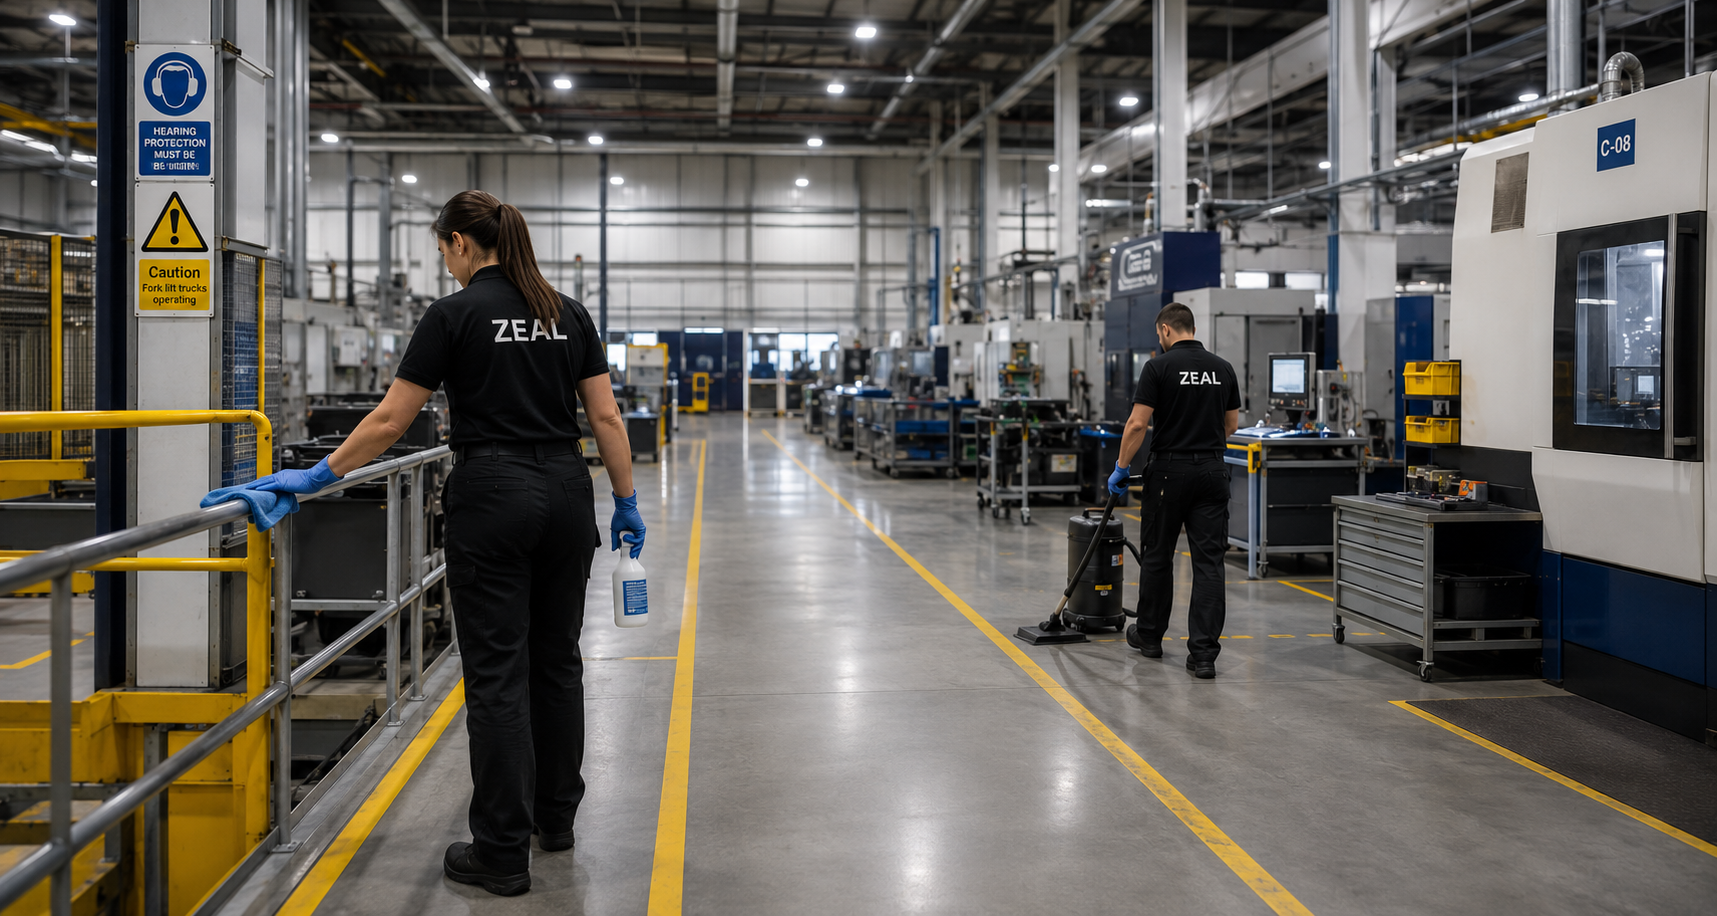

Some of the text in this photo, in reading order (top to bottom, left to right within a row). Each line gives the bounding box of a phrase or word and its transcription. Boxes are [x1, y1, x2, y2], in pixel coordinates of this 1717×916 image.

[153, 127, 197, 135] HEARING
[144, 139, 206, 147] PROTECTION
[1601, 134, 1631, 157] C-08
[154, 150, 195, 159] MUST BE
[149, 265, 200, 278] Caution
[142, 283, 163, 292] Fork
[178, 283, 207, 292] trucks
[153, 295, 197, 306] operating
[491, 318, 568, 343] ZEAL
[1179, 371, 1221, 385] ZEAL
